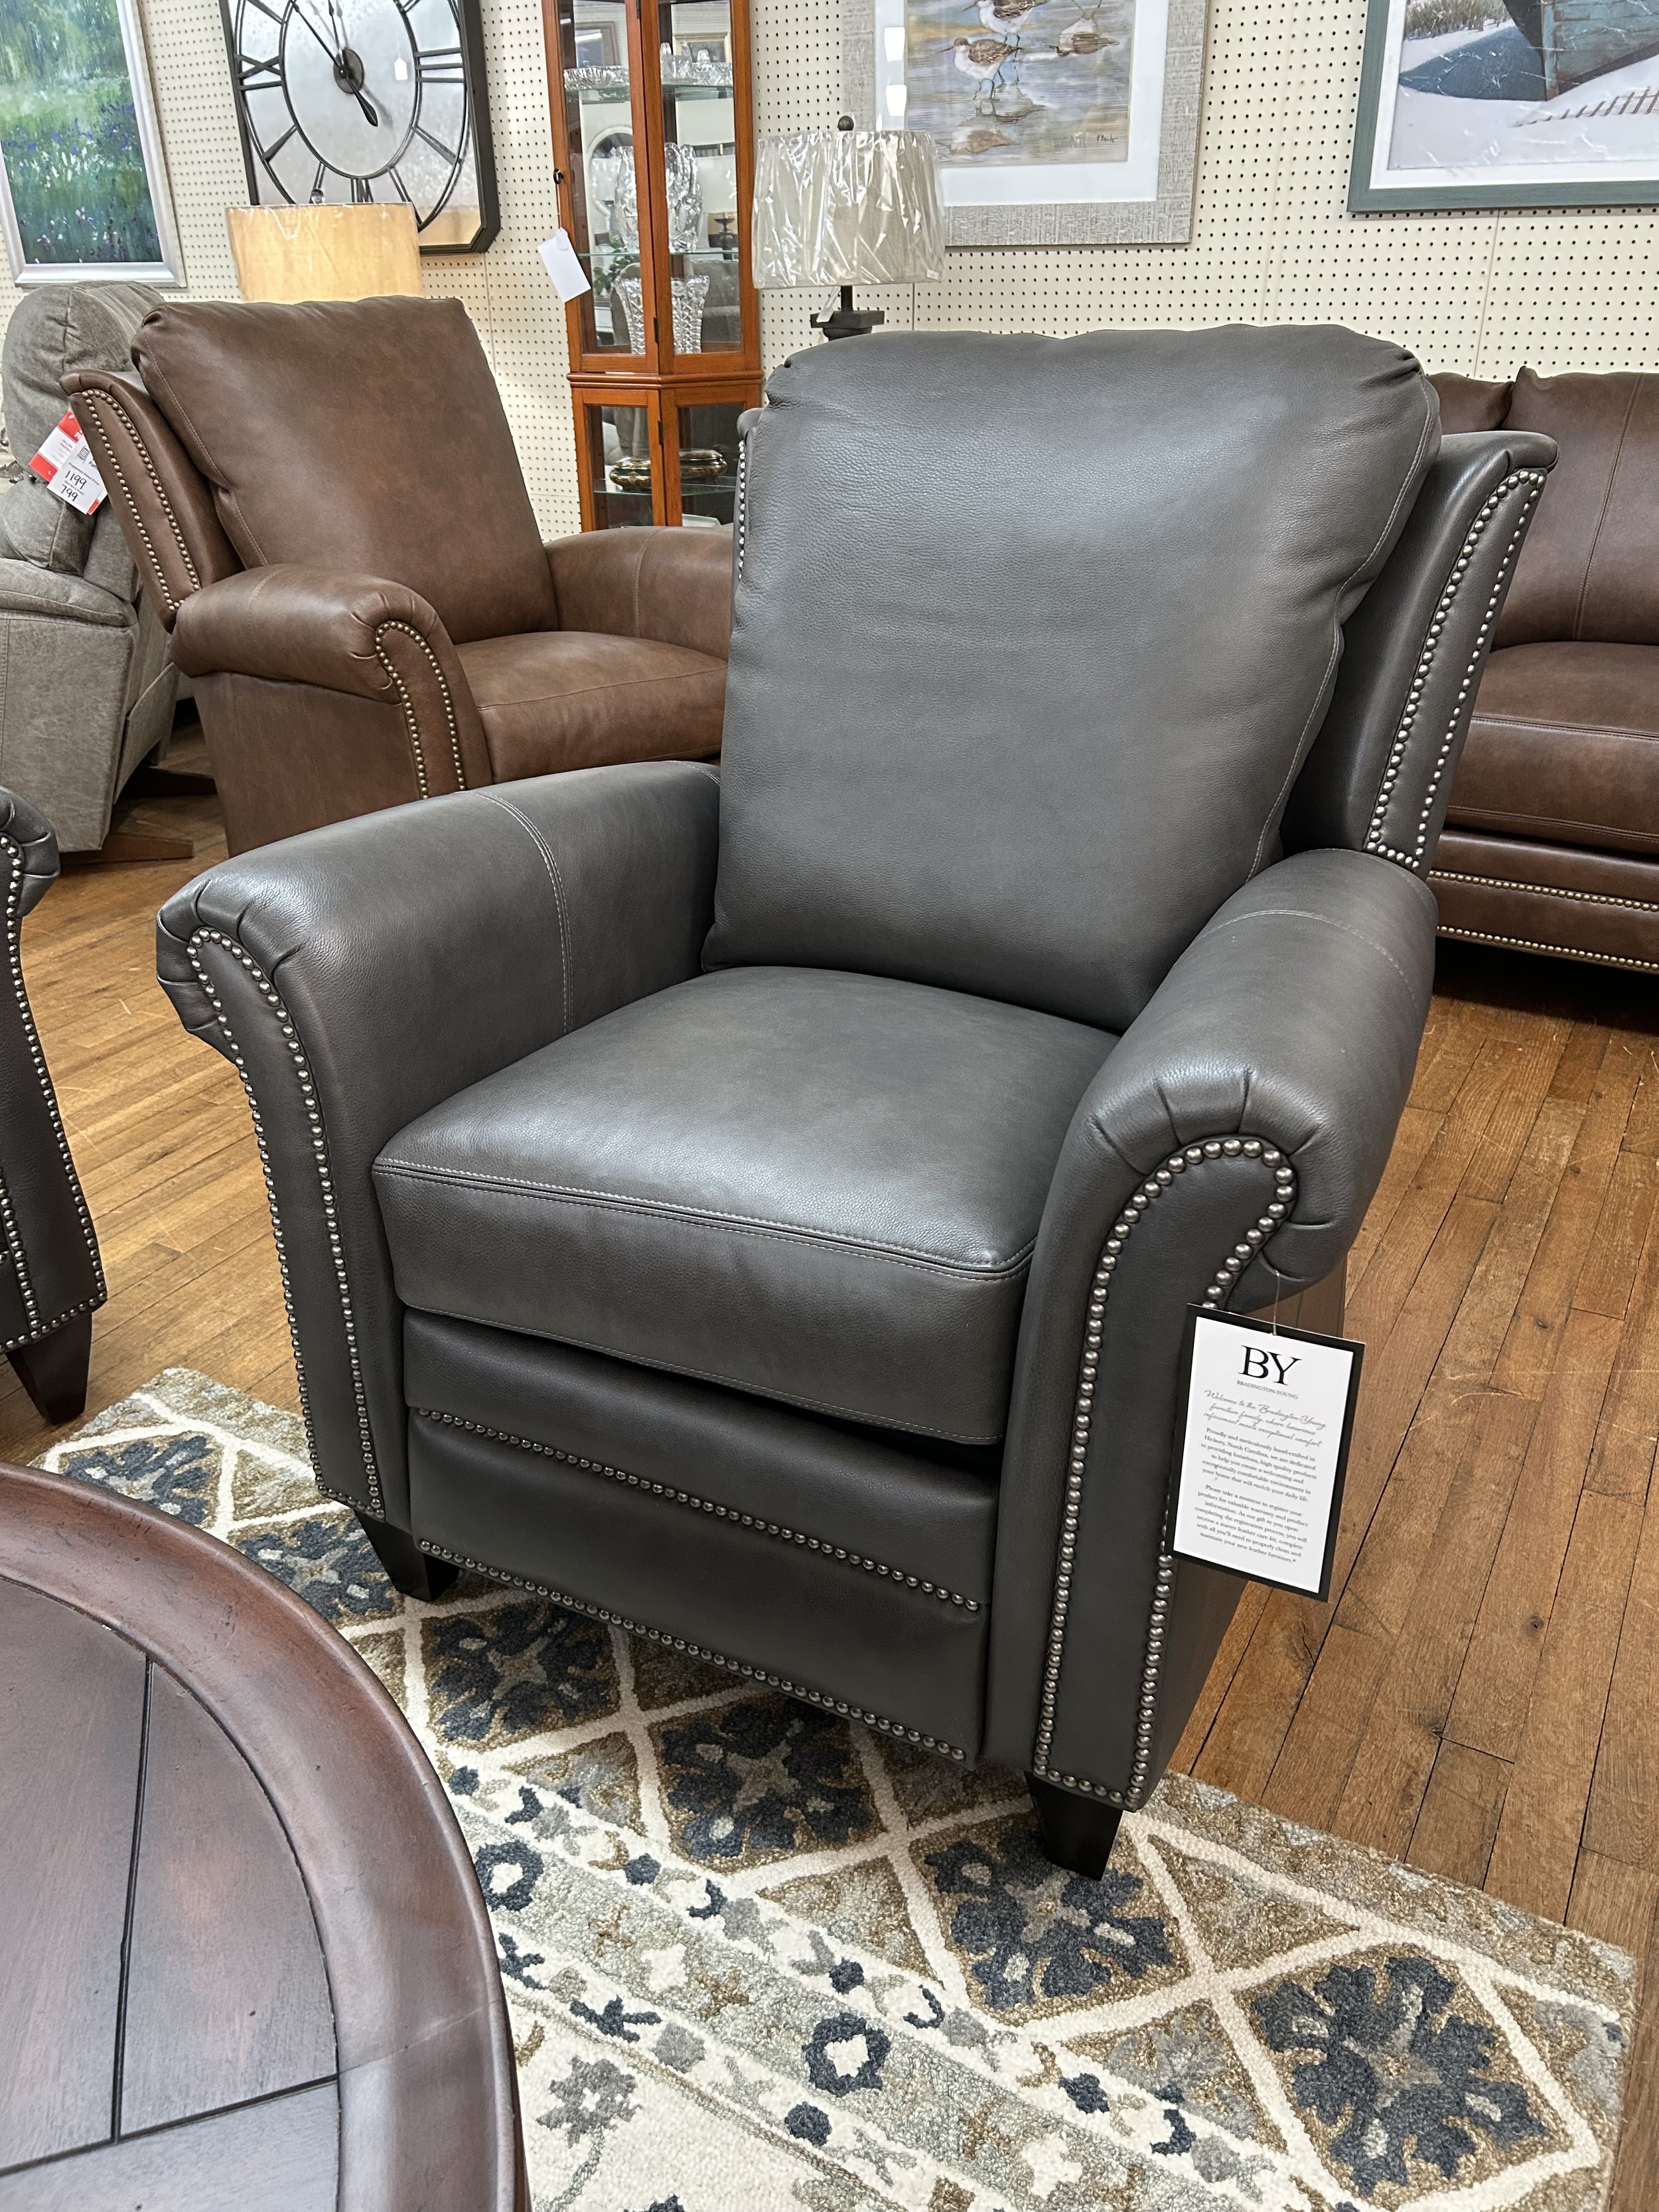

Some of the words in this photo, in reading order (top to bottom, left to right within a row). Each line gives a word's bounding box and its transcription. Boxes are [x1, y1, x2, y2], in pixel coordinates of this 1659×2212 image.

[65, 471, 87, 490] 1199
[61, 484, 78, 502] 799
[1239, 1345, 1302, 1386] BY
[1204, 1390, 1237, 1404] Welcome
[1237, 1380, 1298, 1399] BRADINGTON-YOUNG
[1206, 1427, 1226, 1438] Proudly
[1207, 1445, 1232, 1457] providing
[1273, 1465, 1292, 1473] quality
[1293, 1470, 1317, 1479] products
[1227, 1441, 1243, 1451] North
[1244, 1447, 1269, 1458] Carolina,
[1289, 1460, 1316, 1471] dedicated
[1237, 1471, 1269, 1482] comfortable
[1270, 1480, 1304, 1493] environment
[1263, 1470, 1292, 1482] welcoming
[1205, 1484, 1222, 1493] Please
[1239, 1496, 1261, 1505] moment
[1194, 1507, 1224, 1519] completing
[1234, 1518, 1263, 1530] registration
[1198, 1492, 1218, 1501] product
[1228, 1501, 1249, 1509] valuable
[1250, 1507, 1274, 1518] warranty
[1287, 1518, 1308, 1527] product
[1200, 1532, 1223, 1542] maintain
[1249, 1546, 1267, 1555] leather
[1238, 1526, 1256, 1536] leather
[1279, 1540, 1303, 1550] complete
[1252, 1540, 1274, 1550] properly
